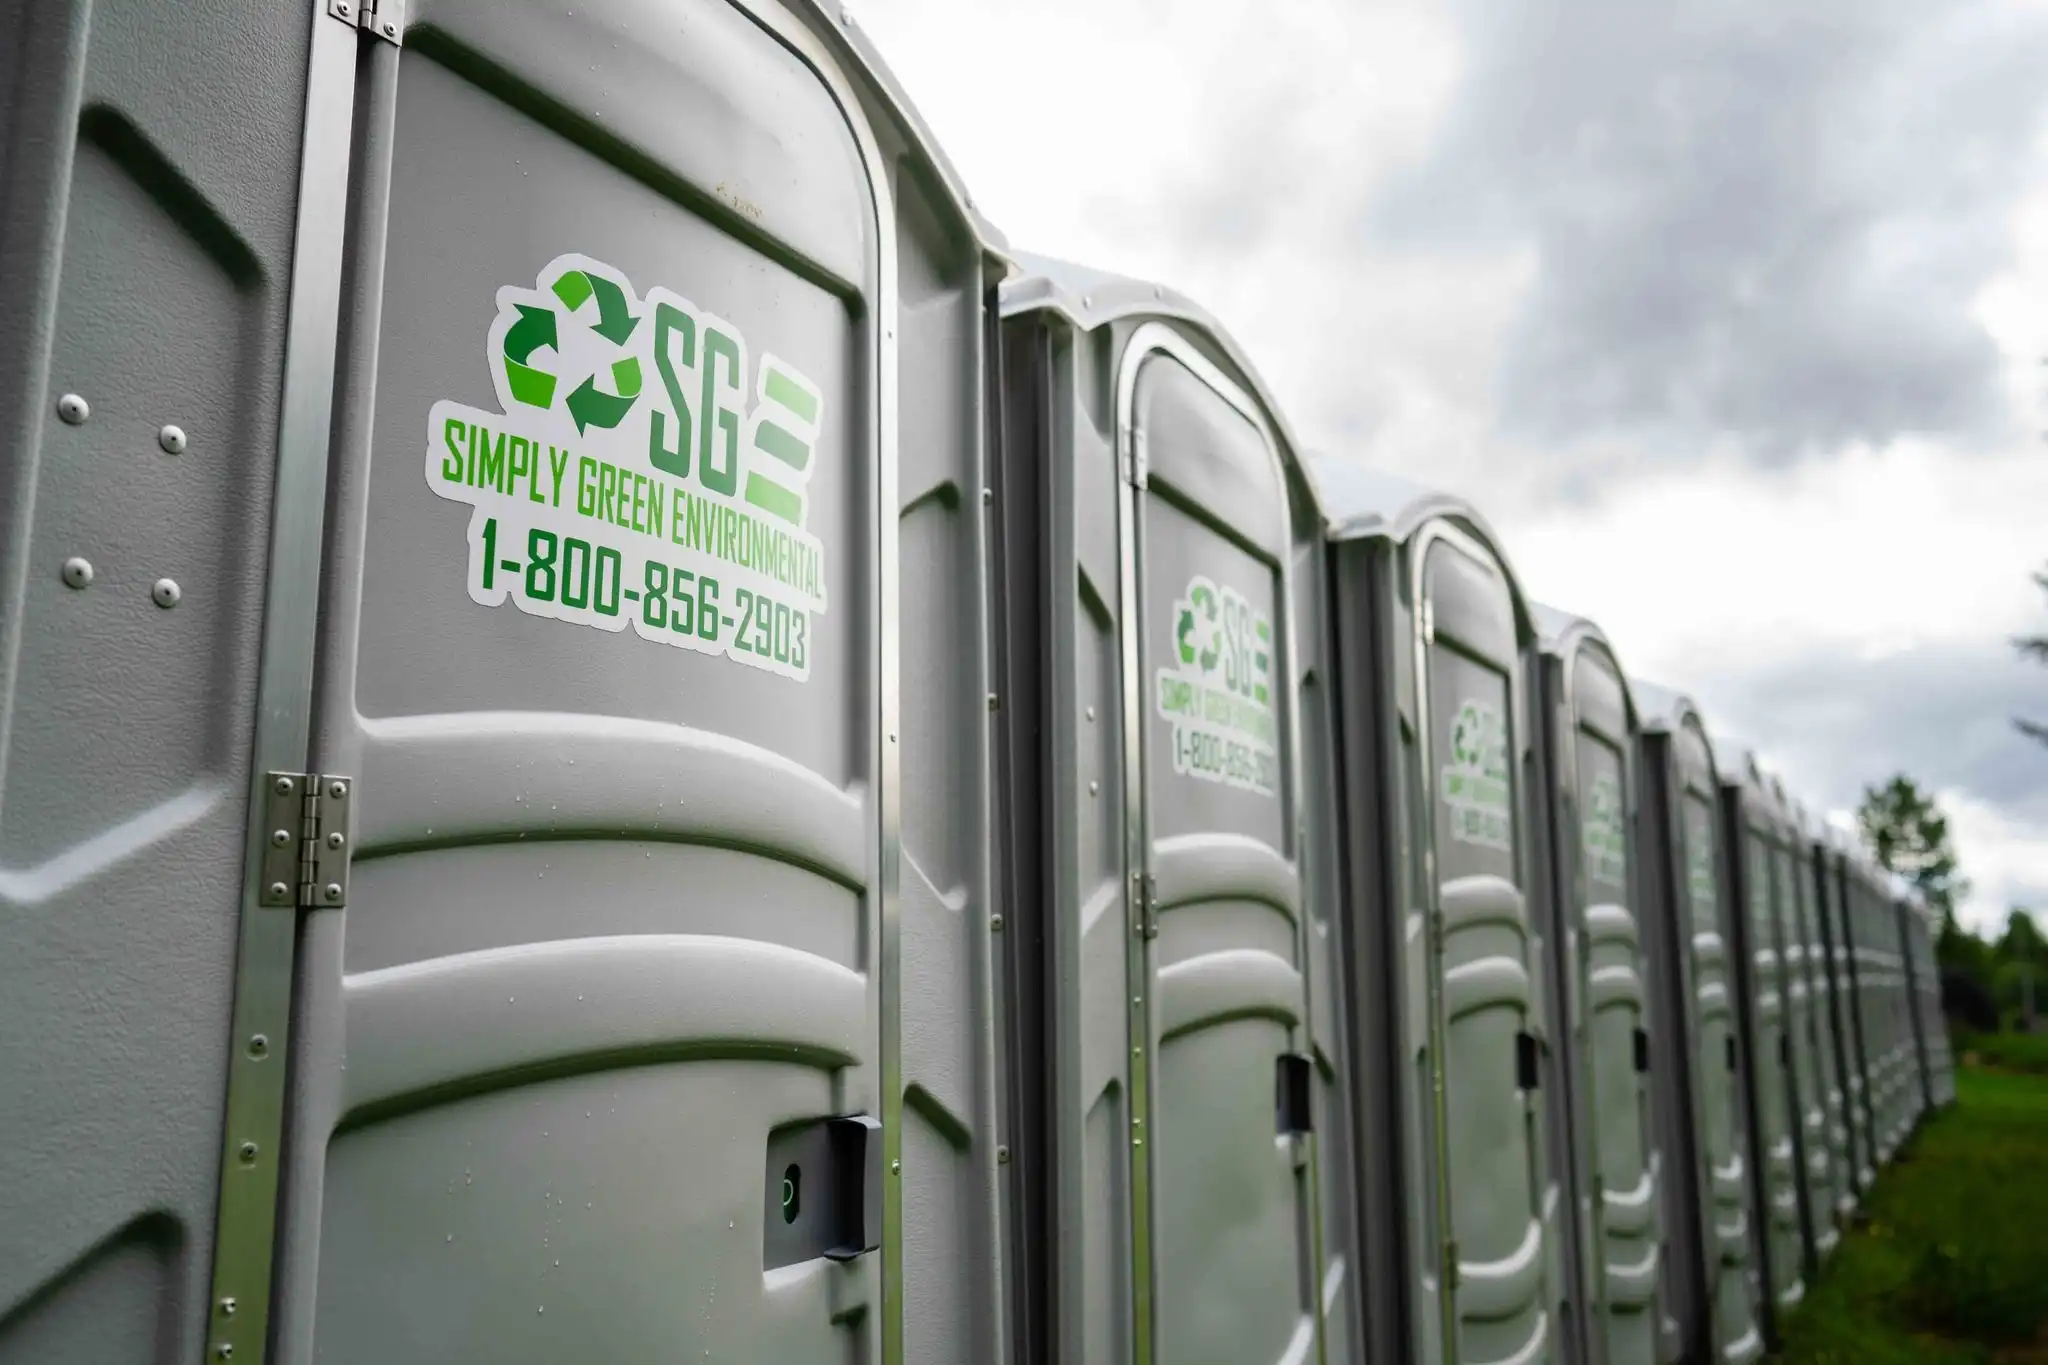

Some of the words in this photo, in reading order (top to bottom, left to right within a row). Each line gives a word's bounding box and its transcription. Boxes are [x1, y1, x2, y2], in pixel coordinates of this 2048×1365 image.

[442, 418, 568, 508] SIMPLY
[577, 455, 664, 538] GREEN
[671, 488, 822, 600] ENVIRONMENTAL
[482, 518, 806, 669] 1-800-856-2903
